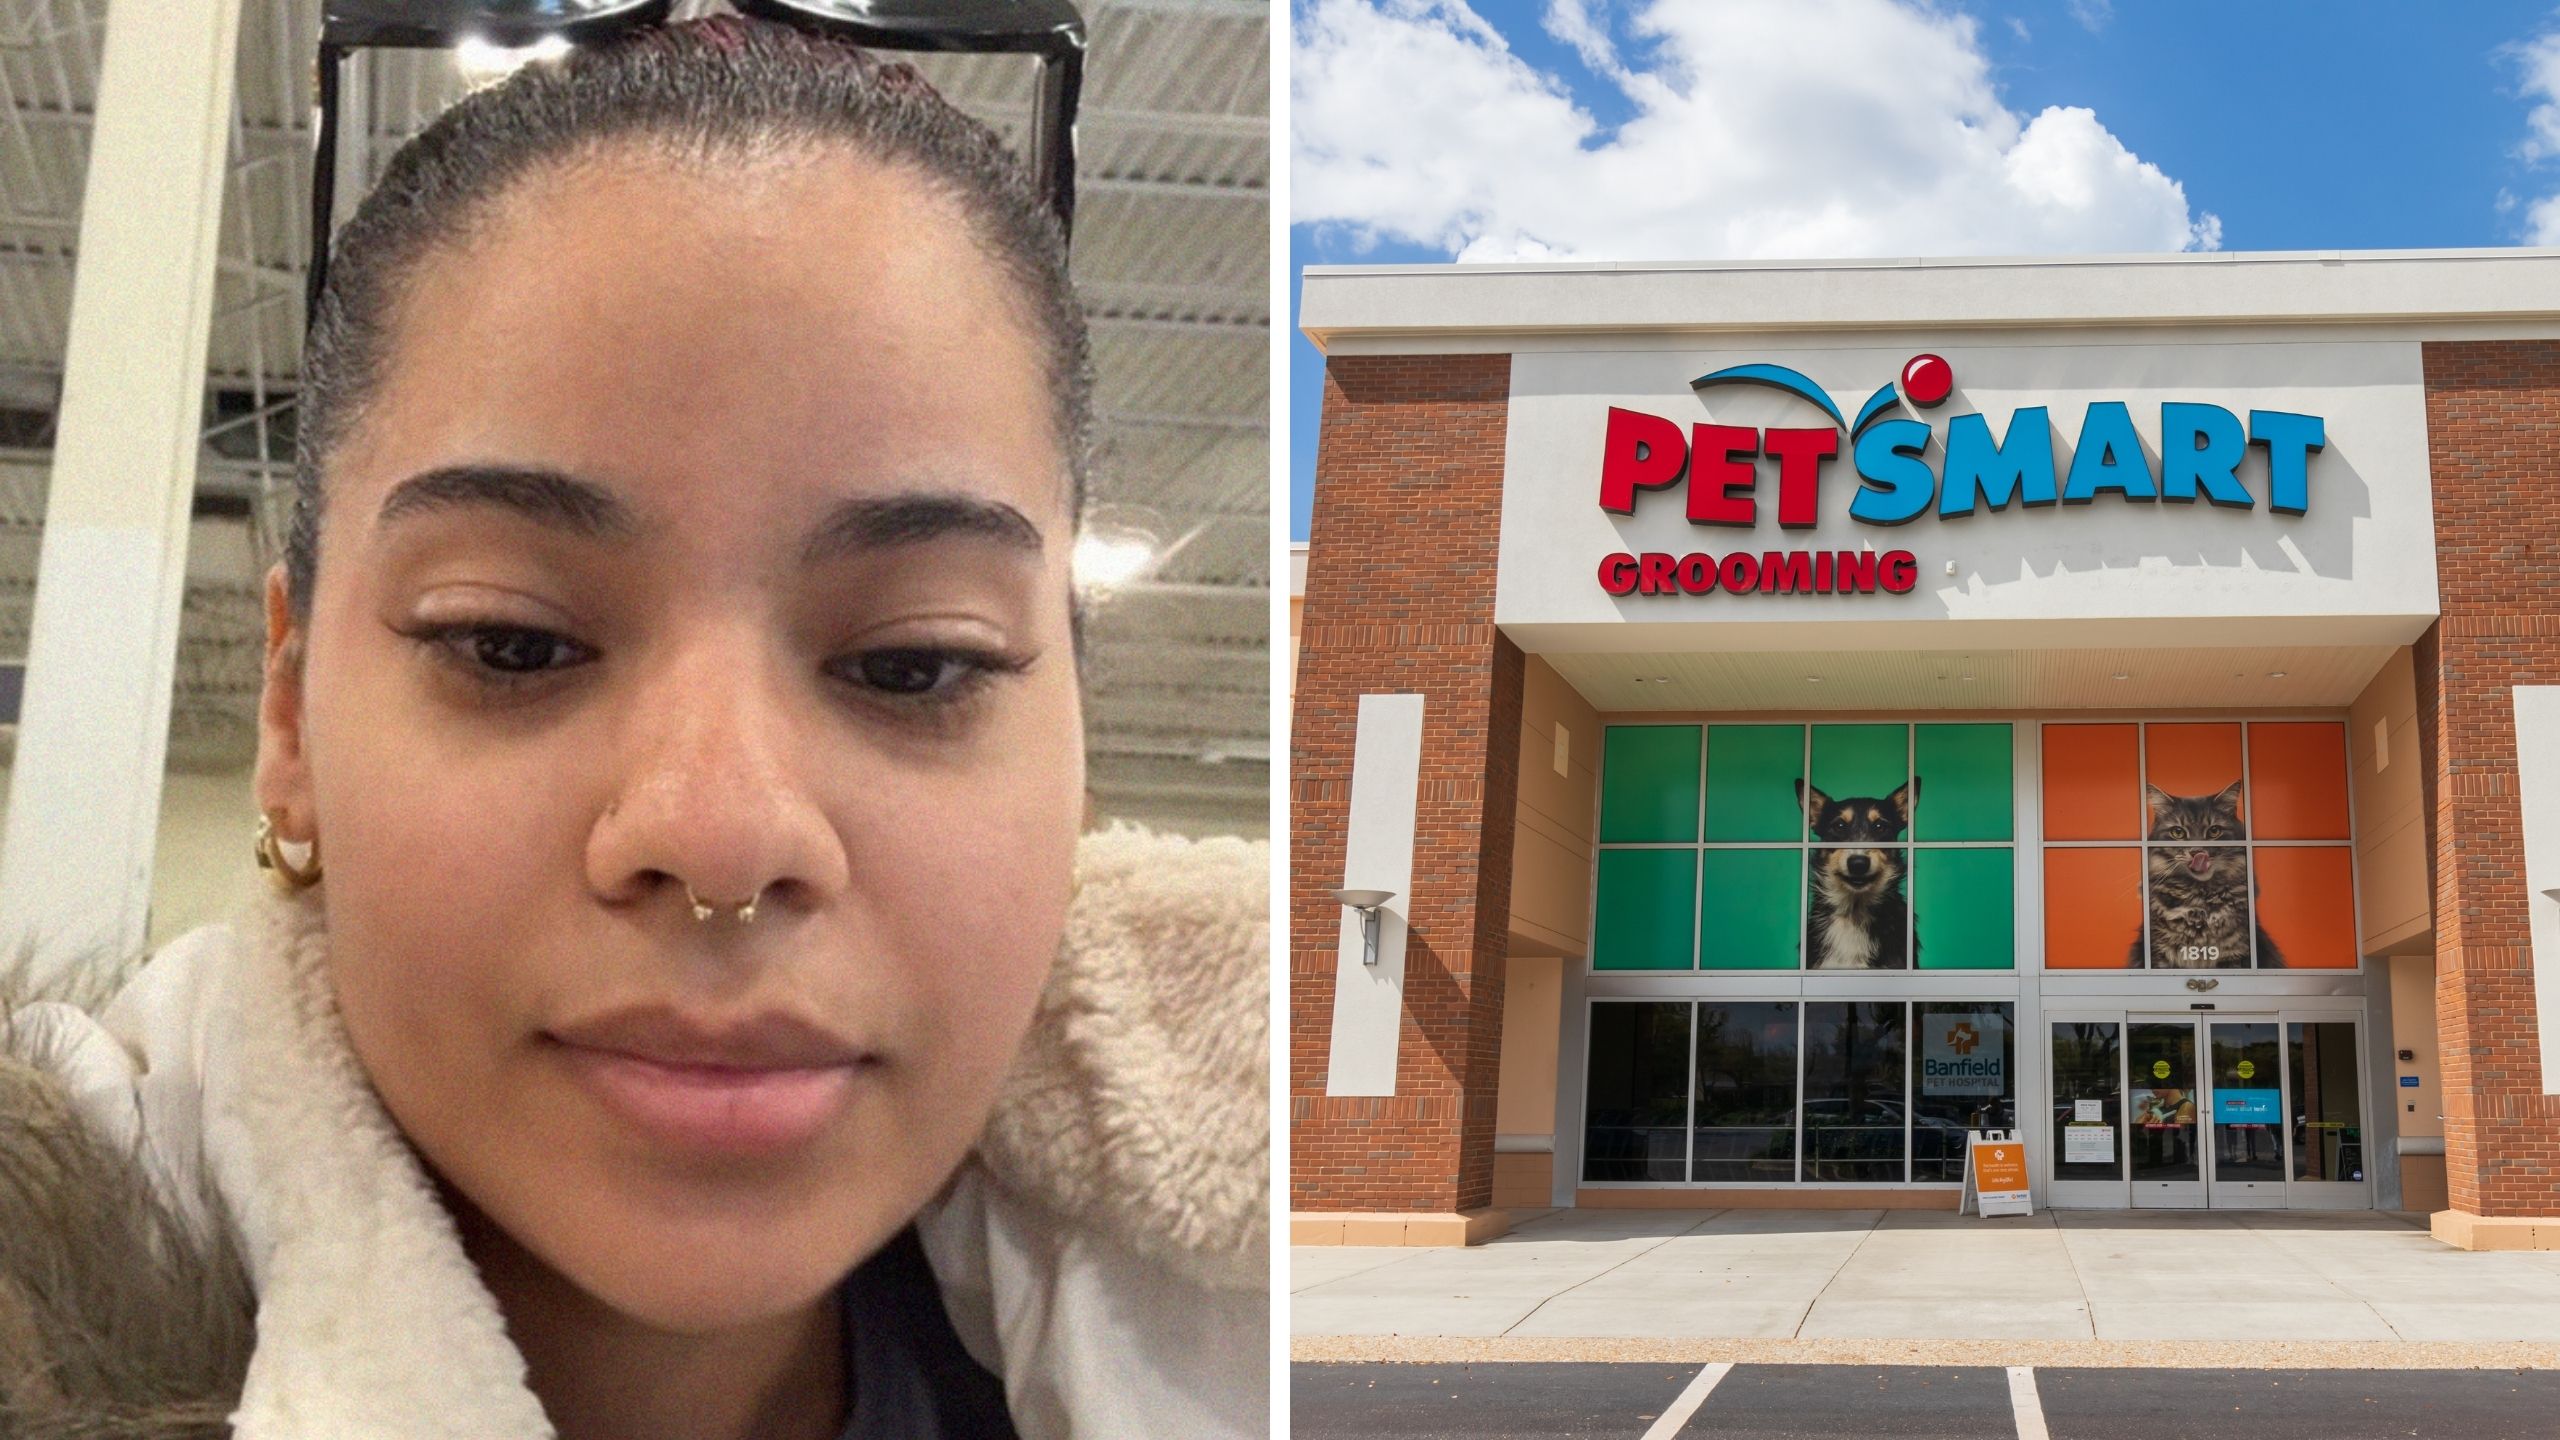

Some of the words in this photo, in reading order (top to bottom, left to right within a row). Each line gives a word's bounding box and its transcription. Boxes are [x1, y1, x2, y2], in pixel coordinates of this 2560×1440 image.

[1598, 400, 2326, 530] PETSMART
[1597, 549, 1918, 597] GROOMING
[2180, 945, 2220, 961] 1819
[1926, 1059, 2000, 1076] Banfield
[1927, 1078, 1945, 1087] PET
